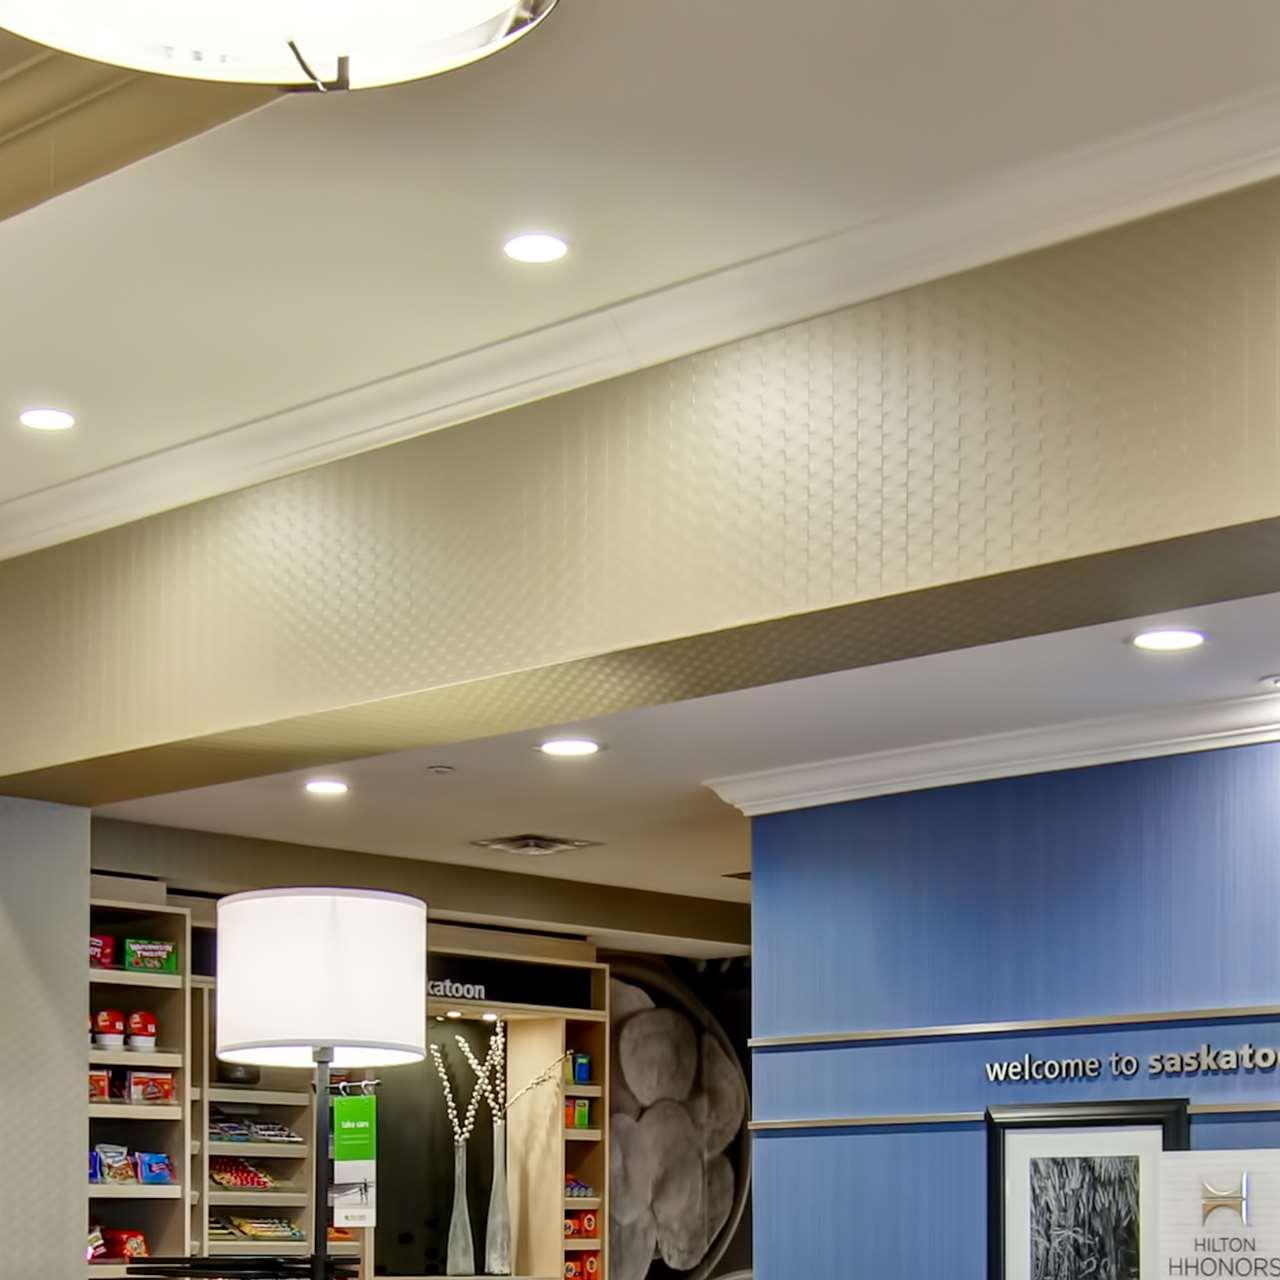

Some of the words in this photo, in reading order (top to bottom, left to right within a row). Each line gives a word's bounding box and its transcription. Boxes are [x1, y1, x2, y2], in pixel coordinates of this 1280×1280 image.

[985, 1053, 1100, 1082] welcome
[1109, 1051, 1139, 1077] to
[1193, 1237, 1256, 1253] HILTON
